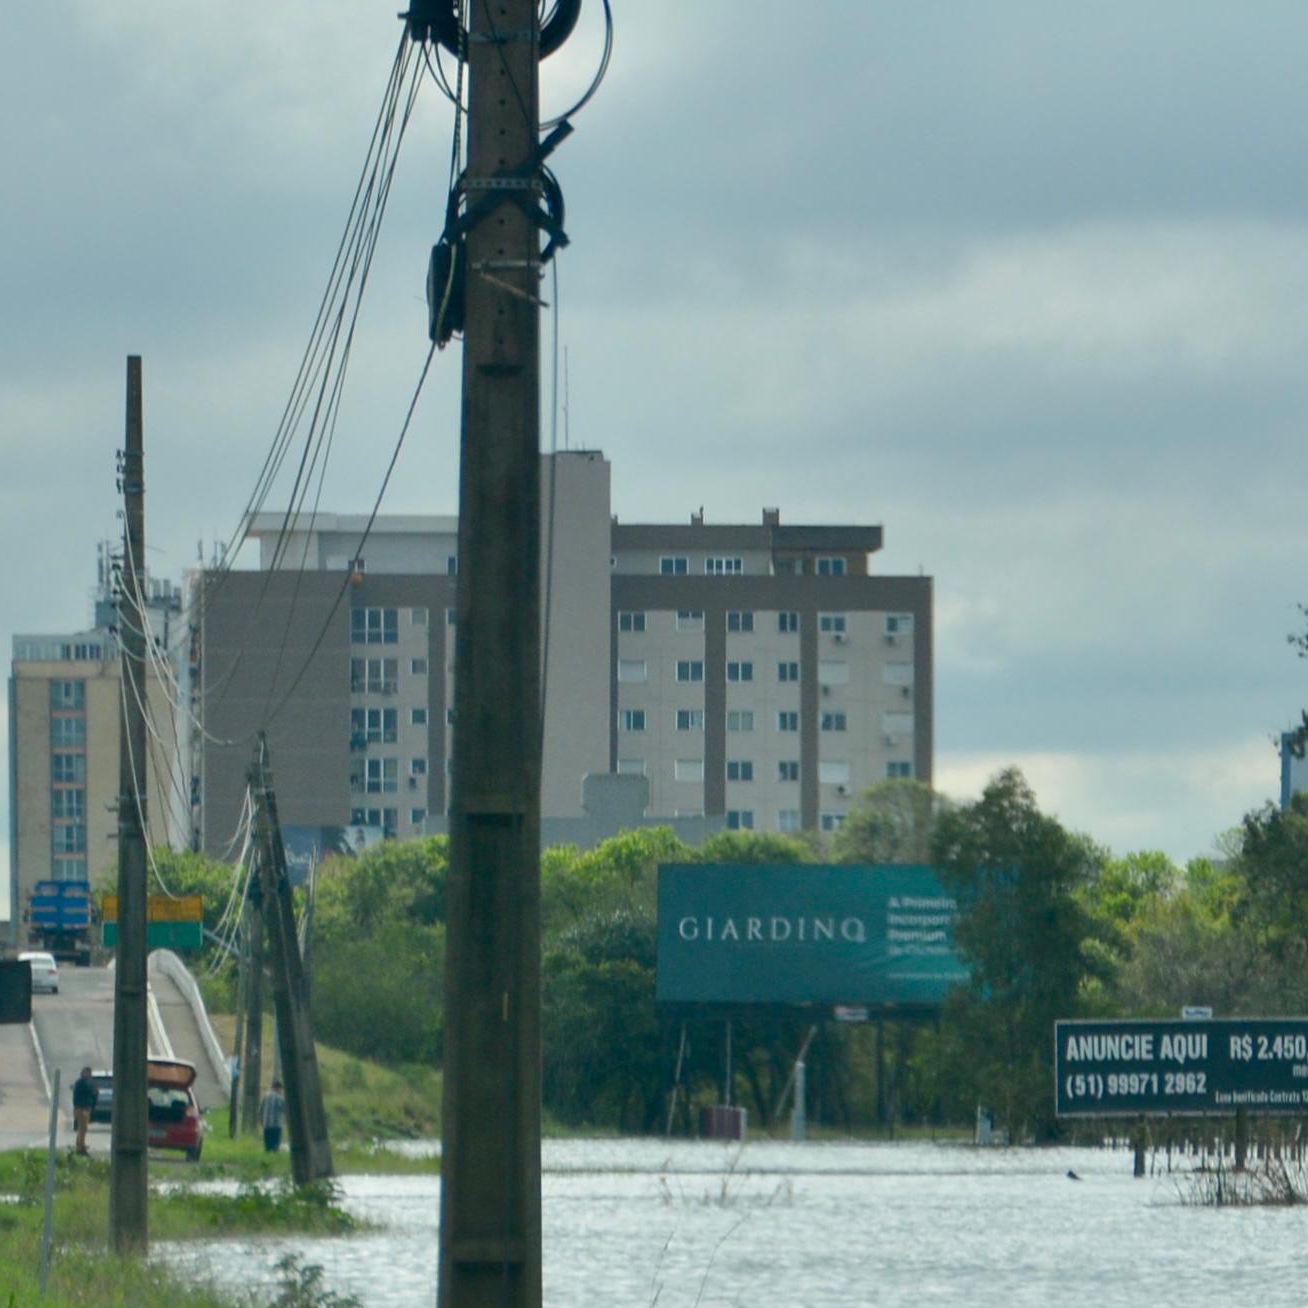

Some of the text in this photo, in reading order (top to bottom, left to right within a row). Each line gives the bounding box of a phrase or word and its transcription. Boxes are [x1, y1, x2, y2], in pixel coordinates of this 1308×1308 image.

[1066, 1032, 1208, 1064] ANUNCIE AQUI
[1229, 1034, 1253, 1062] R$
[1066, 1072, 1207, 1099] (51) 99971 2962
